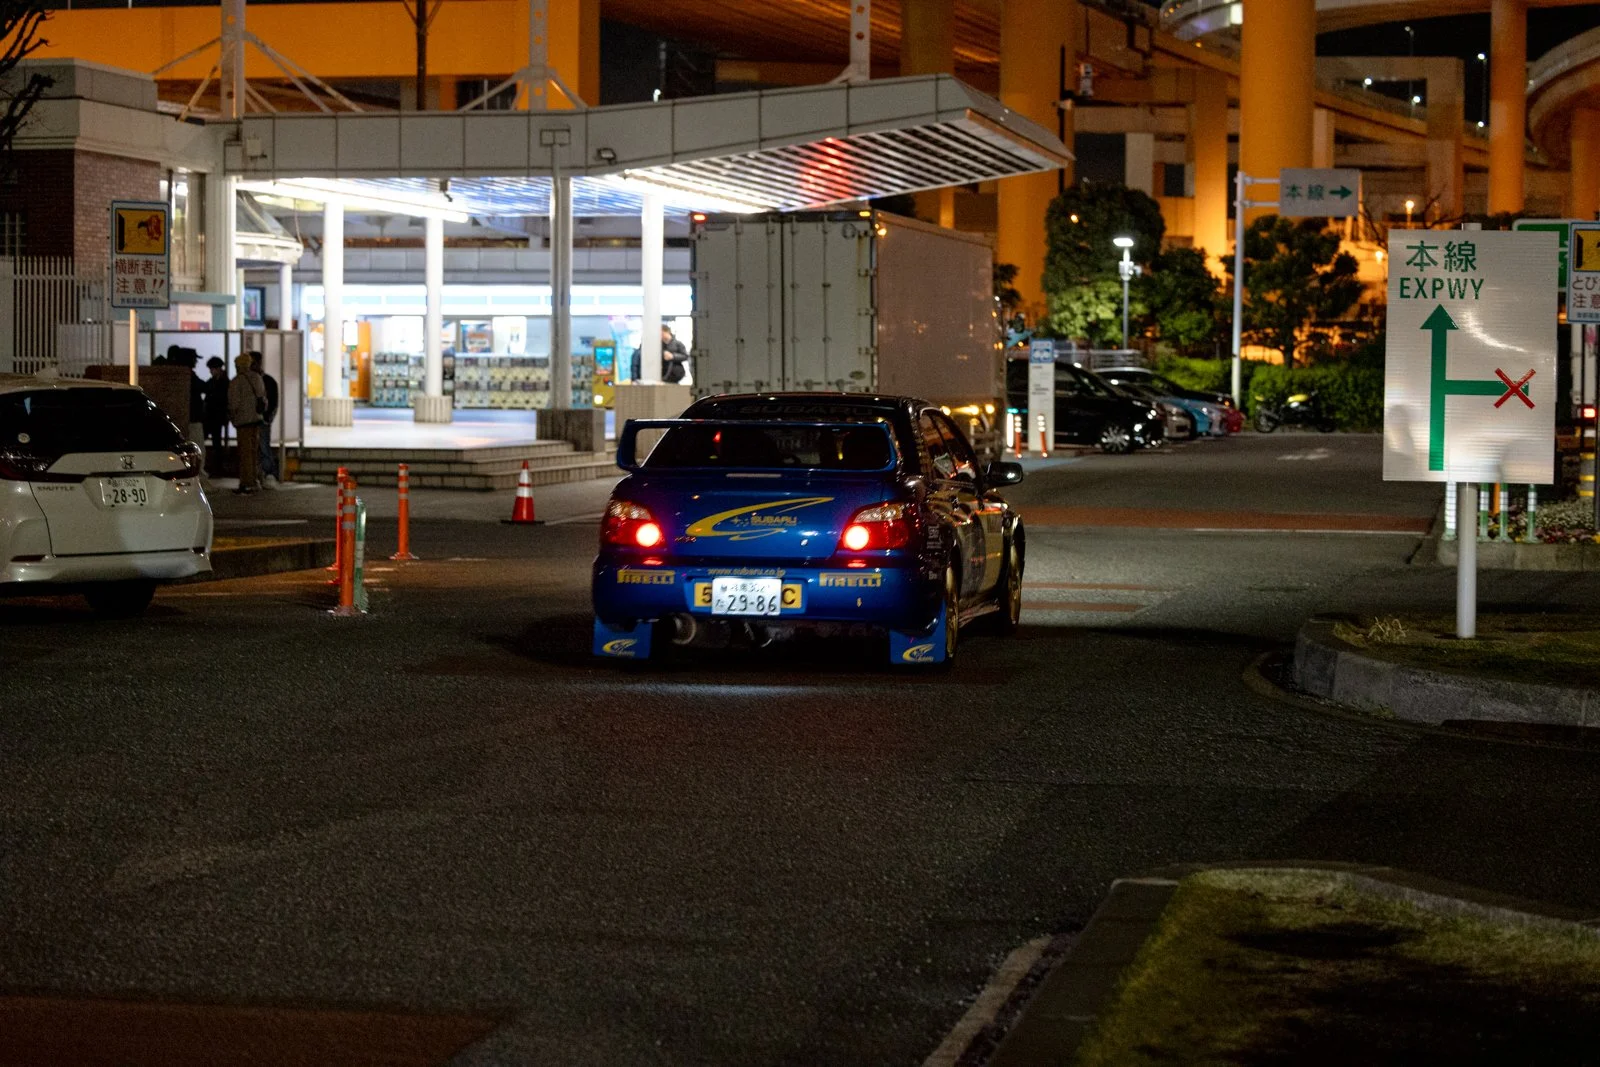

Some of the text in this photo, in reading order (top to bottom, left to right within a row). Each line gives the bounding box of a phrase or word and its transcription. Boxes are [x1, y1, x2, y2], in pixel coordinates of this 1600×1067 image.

[1286, 184, 1324, 200] 本線
[1405, 240, 1478, 274] 本線
[115, 258, 166, 276] 横断者に
[1399, 277, 1485, 300] EXPWY
[739, 403, 873, 416] SUBARU
[112, 488, 147, 503] 28-90
[751, 515, 797, 526] SUBARU
[617, 568, 675, 585] PIRELLI
[707, 566, 786, 578] www.subaru.co.jp
[819, 571, 882, 587] PIRELLI
[726, 593, 778, 612] 29-86
